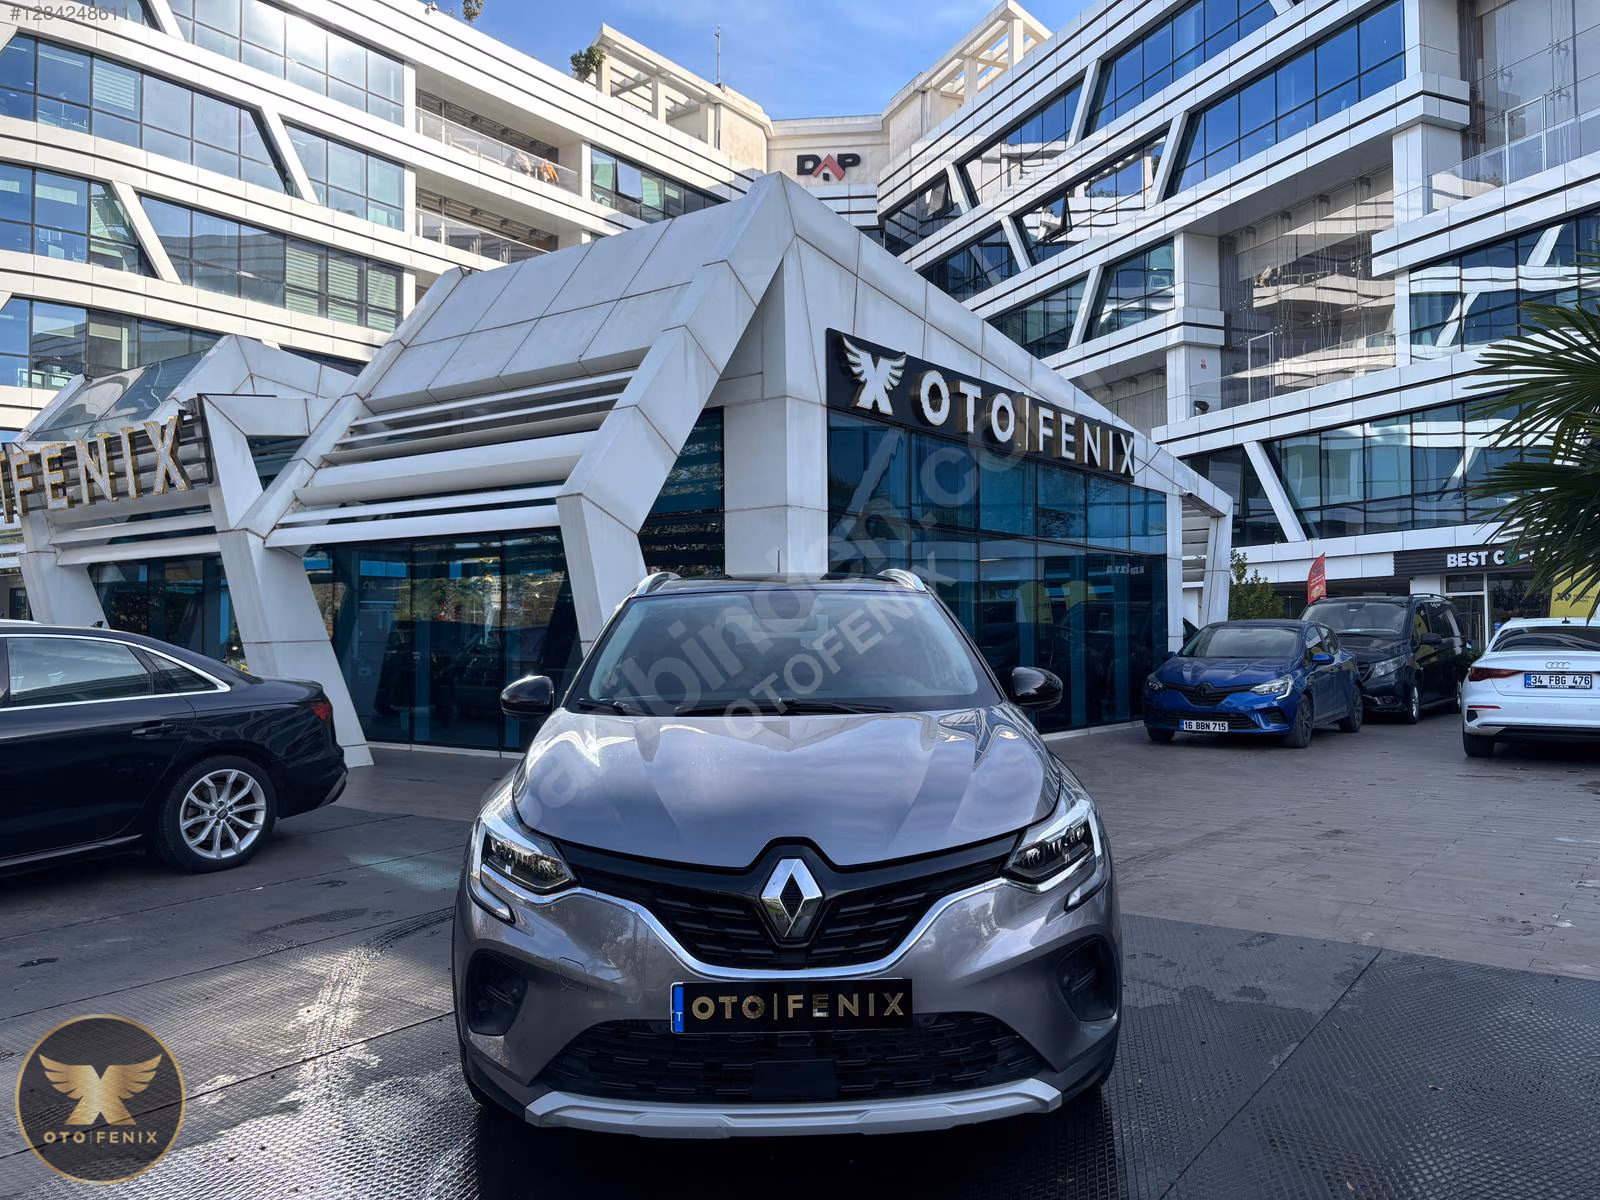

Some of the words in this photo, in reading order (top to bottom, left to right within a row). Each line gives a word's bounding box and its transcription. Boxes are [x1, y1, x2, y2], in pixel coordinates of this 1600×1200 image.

[797, 153, 861, 181] DAP
[1447, 551, 1488, 567] BEST
[1532, 676, 1543, 685] 34
[1549, 676, 1566, 685] FBG
[1572, 676, 1590, 685] 476
[1184, 721, 1193, 730] 16
[1196, 722, 1210, 730] BBN
[1212, 722, 1226, 731] 715
